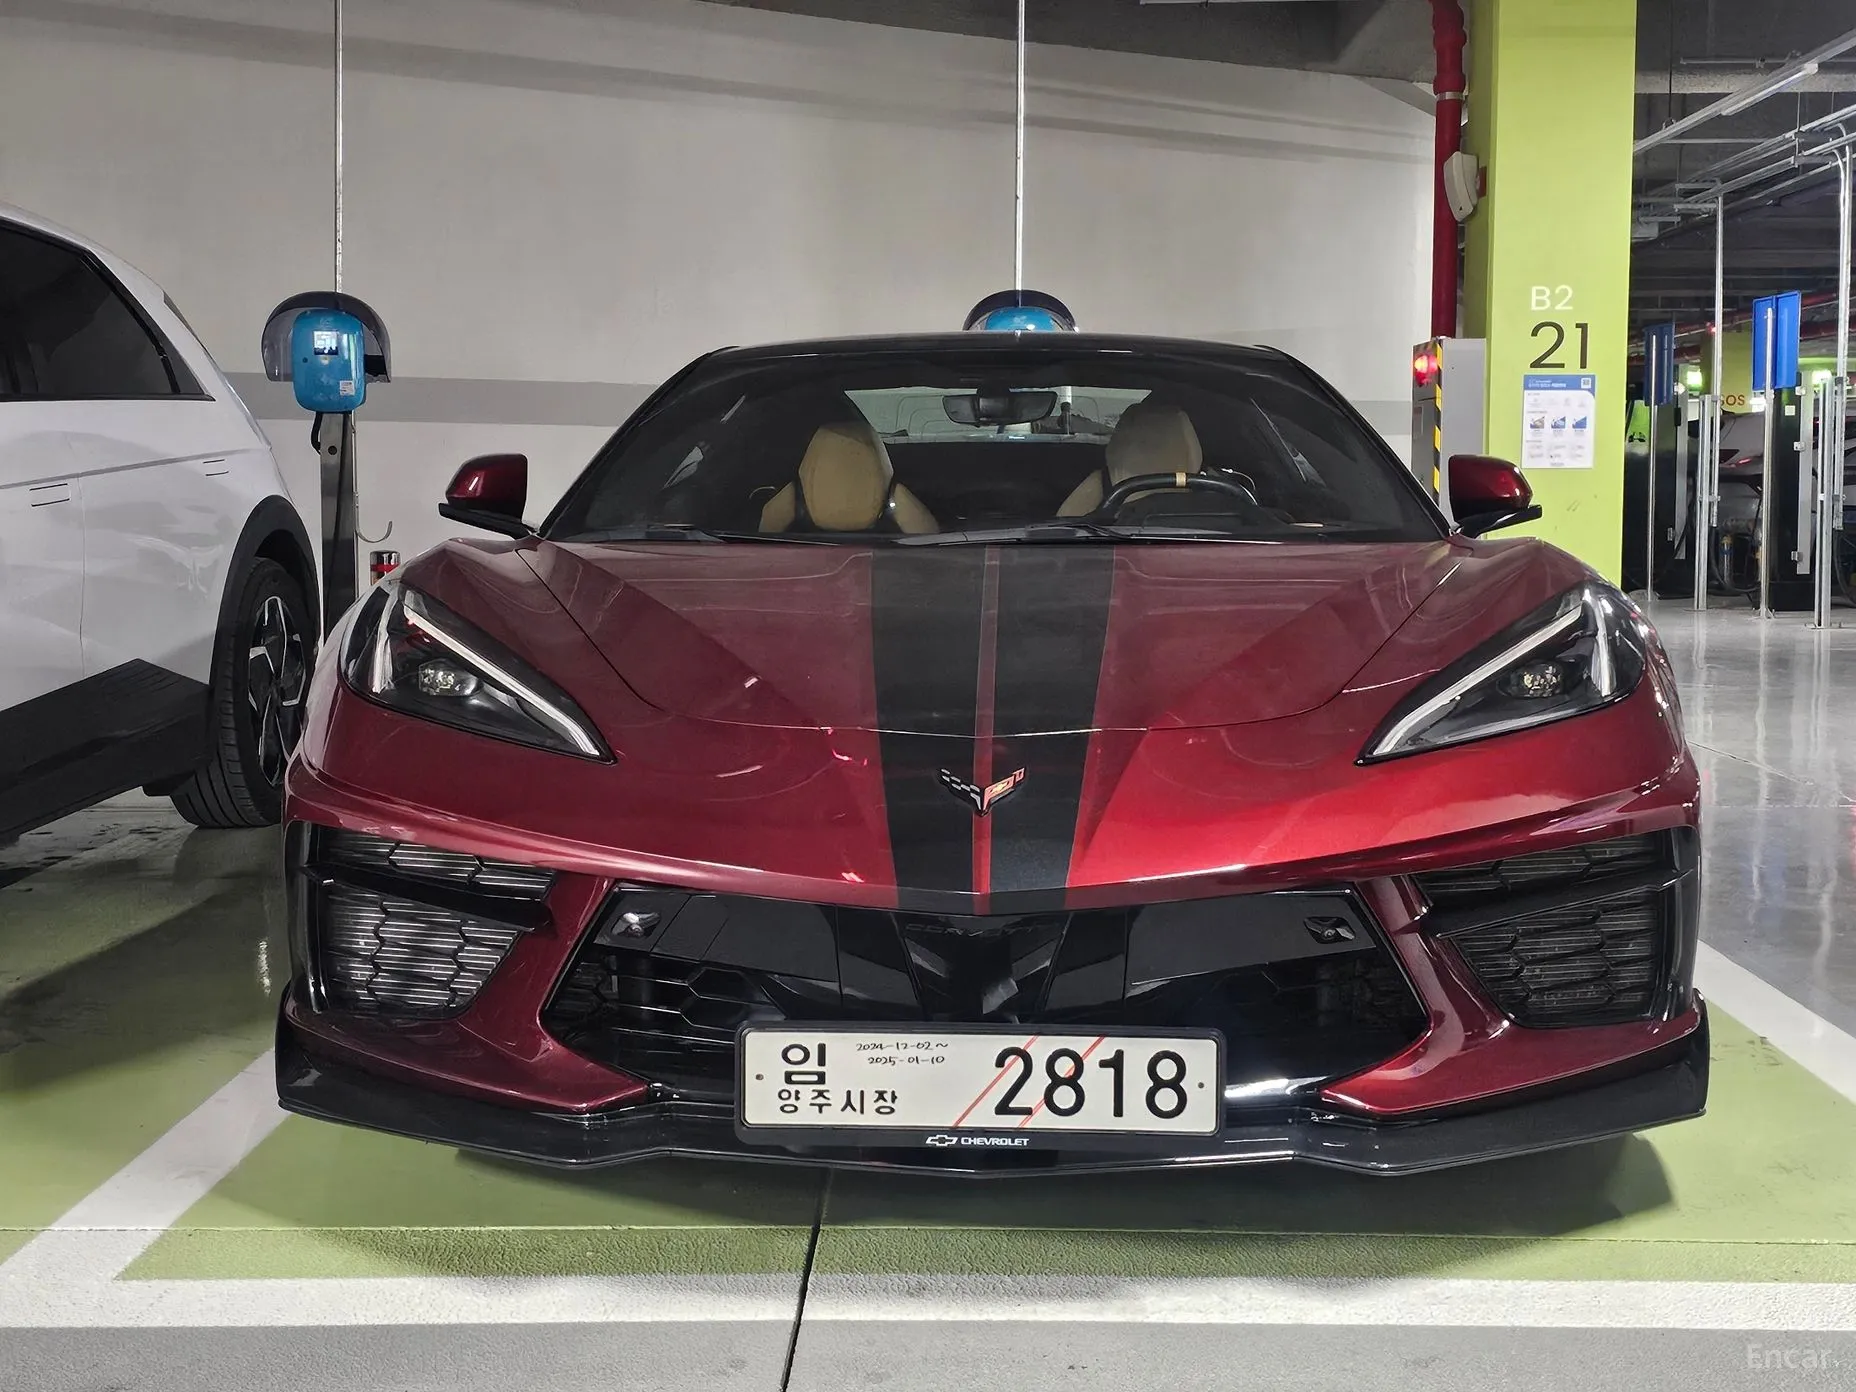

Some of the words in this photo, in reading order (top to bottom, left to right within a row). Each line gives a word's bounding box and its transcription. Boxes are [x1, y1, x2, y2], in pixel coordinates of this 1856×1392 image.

[1530, 285, 1574, 311] B2
[1529, 321, 1589, 370] 21
[781, 1043, 826, 1085] 임
[867, 1055, 945, 1066] 2025-01-10
[994, 1047, 1187, 1119] 2818
[777, 1088, 898, 1115] 양주시장
[960, 1136, 1030, 1146] CHEVROLET
